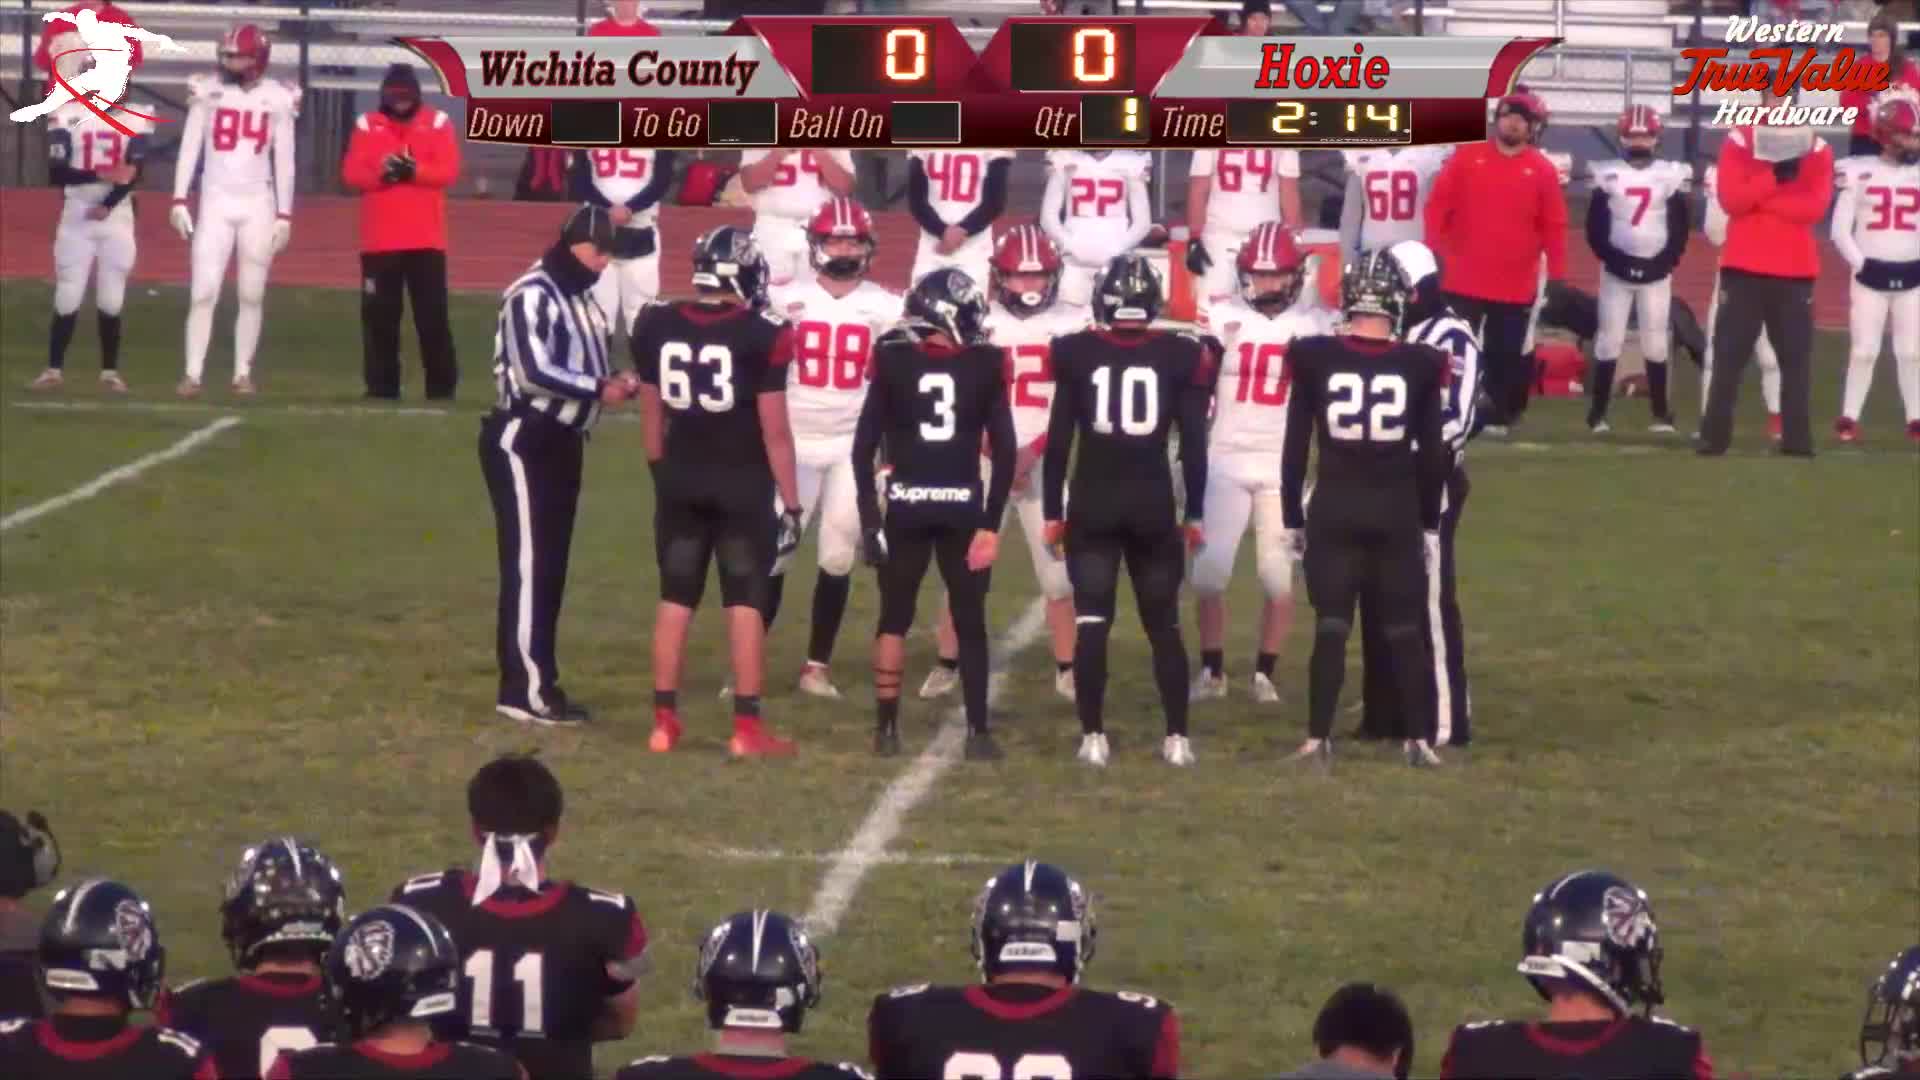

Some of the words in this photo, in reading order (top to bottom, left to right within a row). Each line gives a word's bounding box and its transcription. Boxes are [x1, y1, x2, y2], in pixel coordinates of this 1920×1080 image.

[82, 131, 122, 175] 13
[212, 108, 269, 154] 84
[592, 148, 647, 178] 85
[927, 153, 980, 203] 40
[1218, 148, 1273, 193] 64
[1364, 171, 1418, 221] 68
[1625, 187, 1653, 227] 7
[1866, 186, 1920, 231] 32
[660, 342, 735, 412] 63
[796, 320, 872, 390] 88
[1236, 342, 1290, 406] 10
[918, 373, 957, 442] 3
[1091, 366, 1159, 435] 10
[1326, 372, 1408, 442] 22
[889, 482, 971, 503] Supreme
[464, 948, 546, 1037] 11
